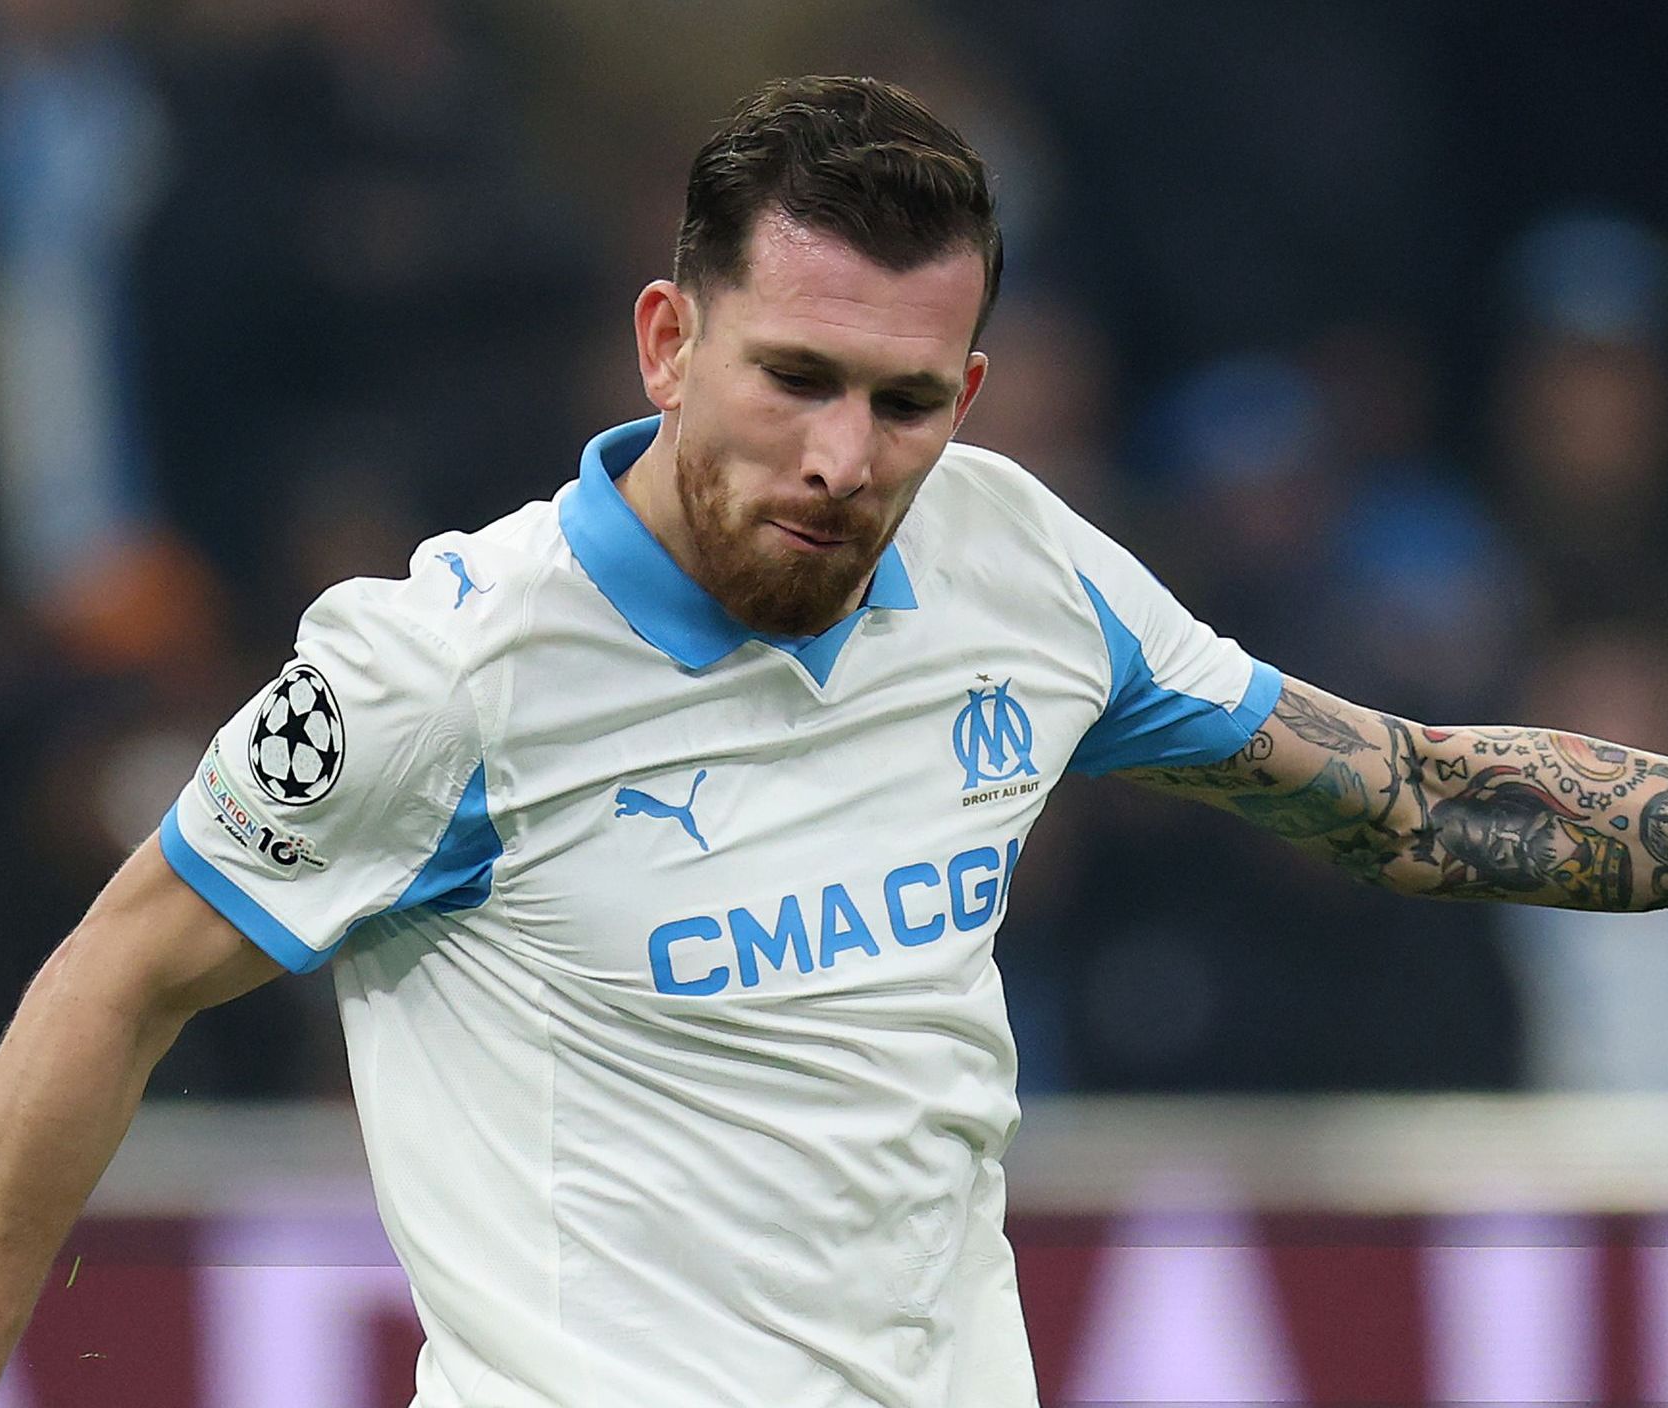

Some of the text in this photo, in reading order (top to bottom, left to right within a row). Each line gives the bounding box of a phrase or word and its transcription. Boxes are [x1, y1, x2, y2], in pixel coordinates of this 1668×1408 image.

[962, 781, 1041, 807] DROIT AU BUT
[648, 837, 1020, 997] CMA CG
